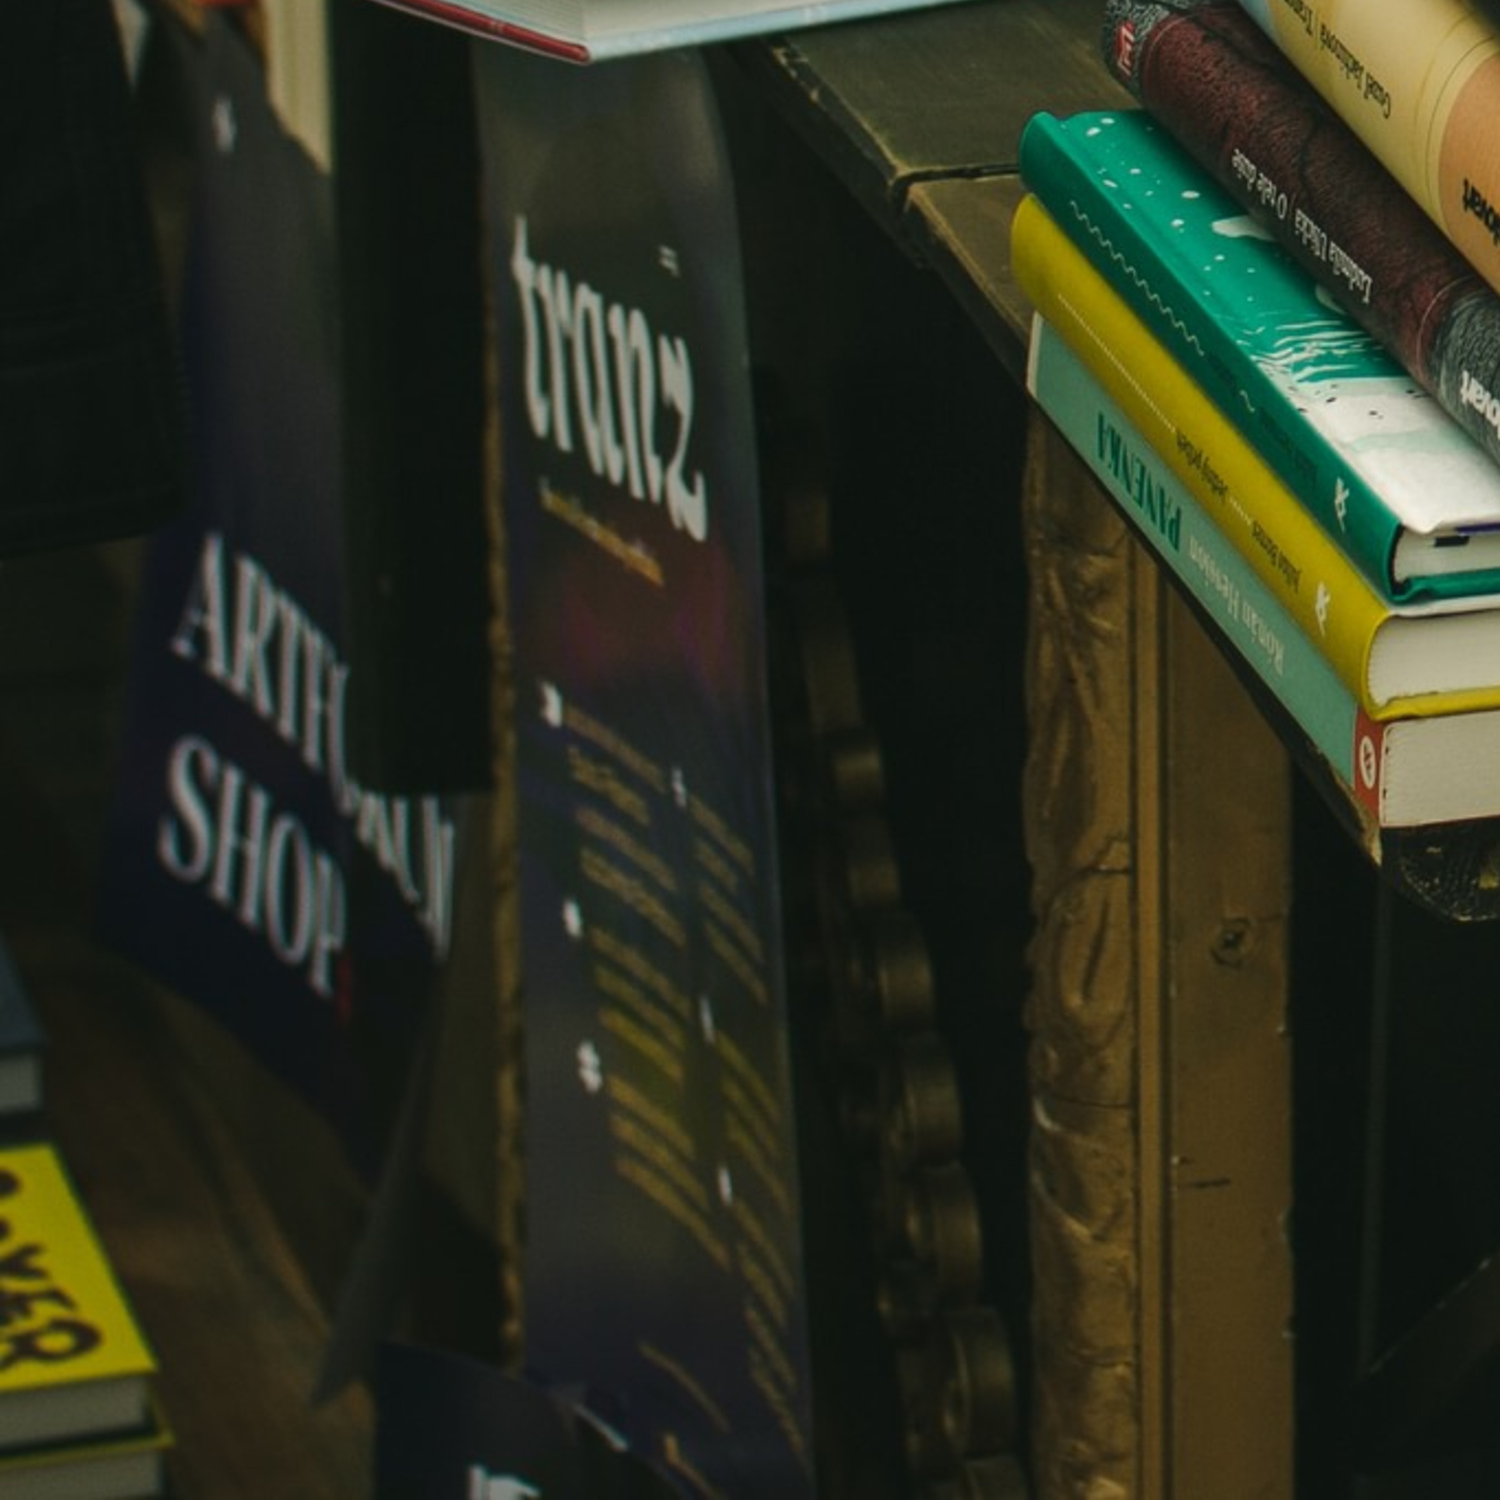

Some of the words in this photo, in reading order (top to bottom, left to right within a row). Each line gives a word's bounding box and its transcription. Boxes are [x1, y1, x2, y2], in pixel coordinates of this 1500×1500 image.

[1276, 192, 1288, 220] O
[1295, 207, 1327, 262] Ulická
[1096, 411, 1182, 554] PANENKA
[157, 733, 347, 999] SHOP
